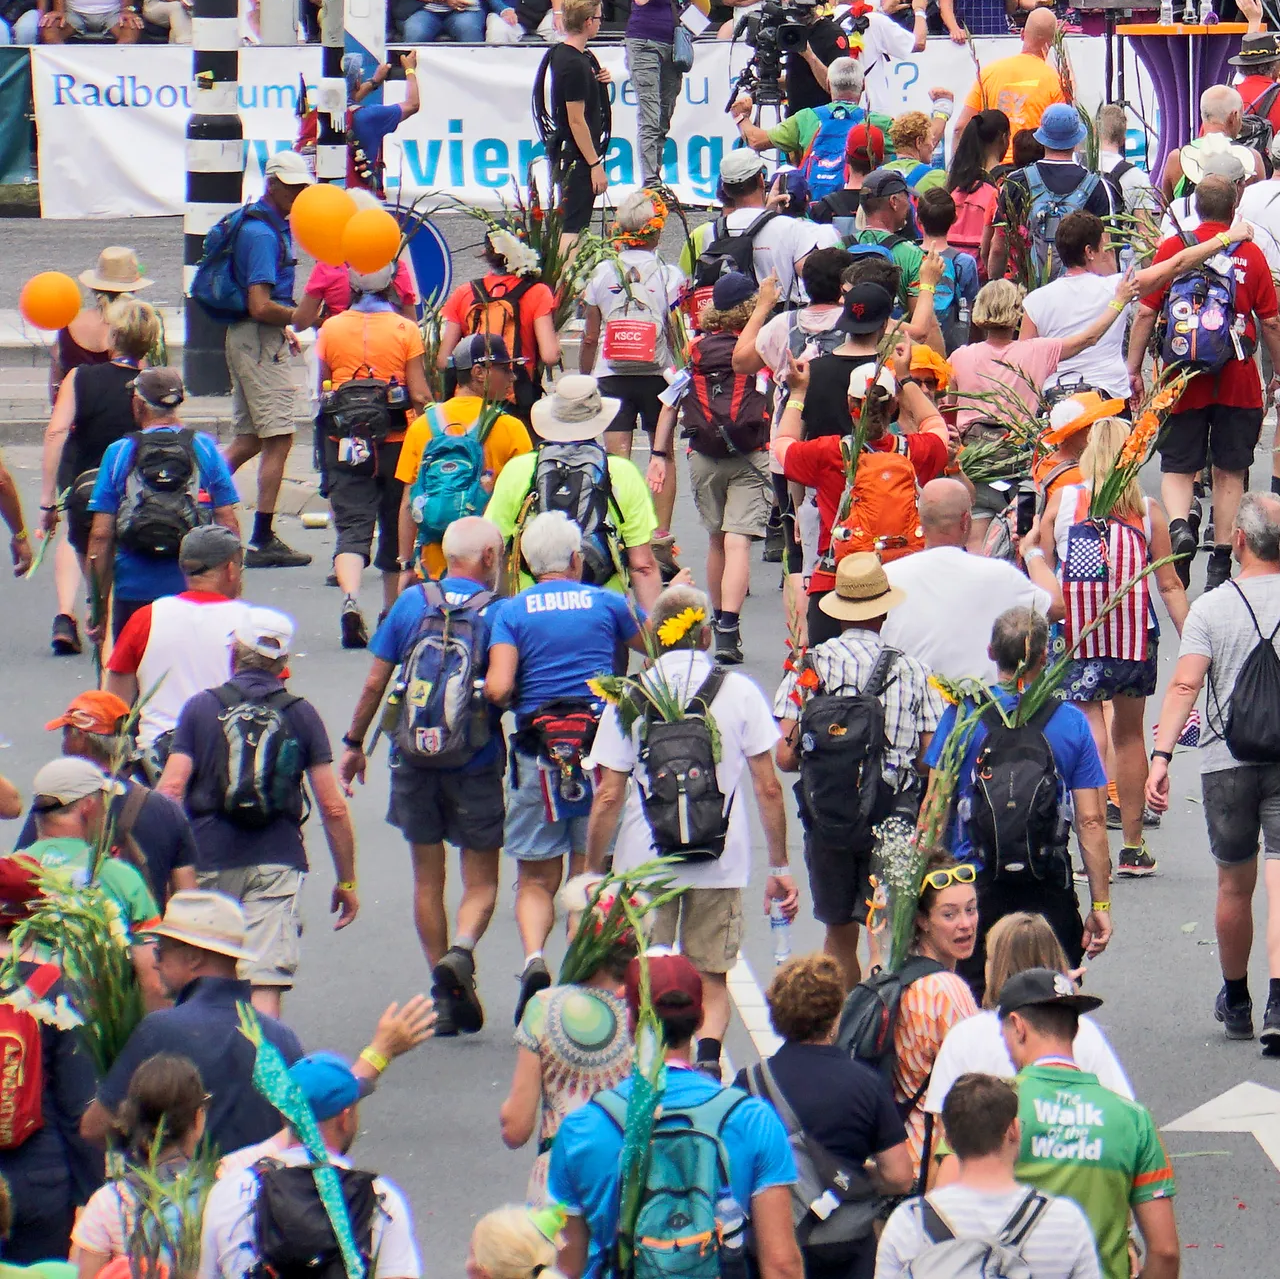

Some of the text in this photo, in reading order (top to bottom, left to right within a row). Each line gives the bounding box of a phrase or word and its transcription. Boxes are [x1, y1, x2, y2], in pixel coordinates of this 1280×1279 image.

[614, 331, 642, 341] KSCC
[526, 590, 592, 614] ELBURG
[1055, 1090, 1081, 1106] The
[1033, 1098, 1104, 1127] Walk
[1048, 1124, 1089, 1140] of the
[1031, 1135, 1103, 1161] World
